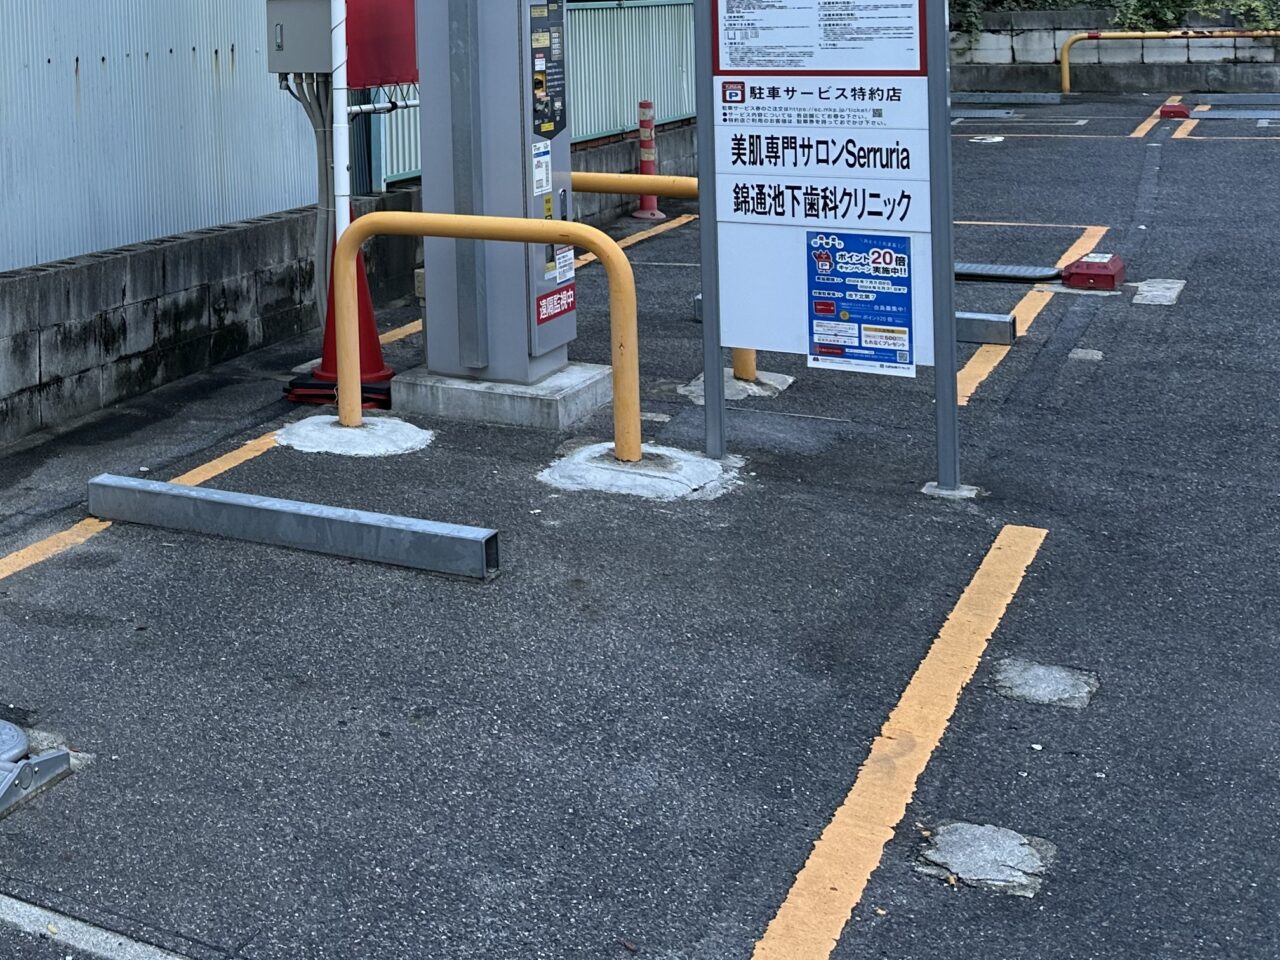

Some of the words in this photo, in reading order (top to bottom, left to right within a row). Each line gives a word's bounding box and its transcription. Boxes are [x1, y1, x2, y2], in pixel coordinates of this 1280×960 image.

[749, 86, 902, 103] 駐車サービス特約店
[731, 134, 911, 170] 美肌専門サロンSerruria
[733, 183, 912, 222] 錦通池下歯科クリニック
